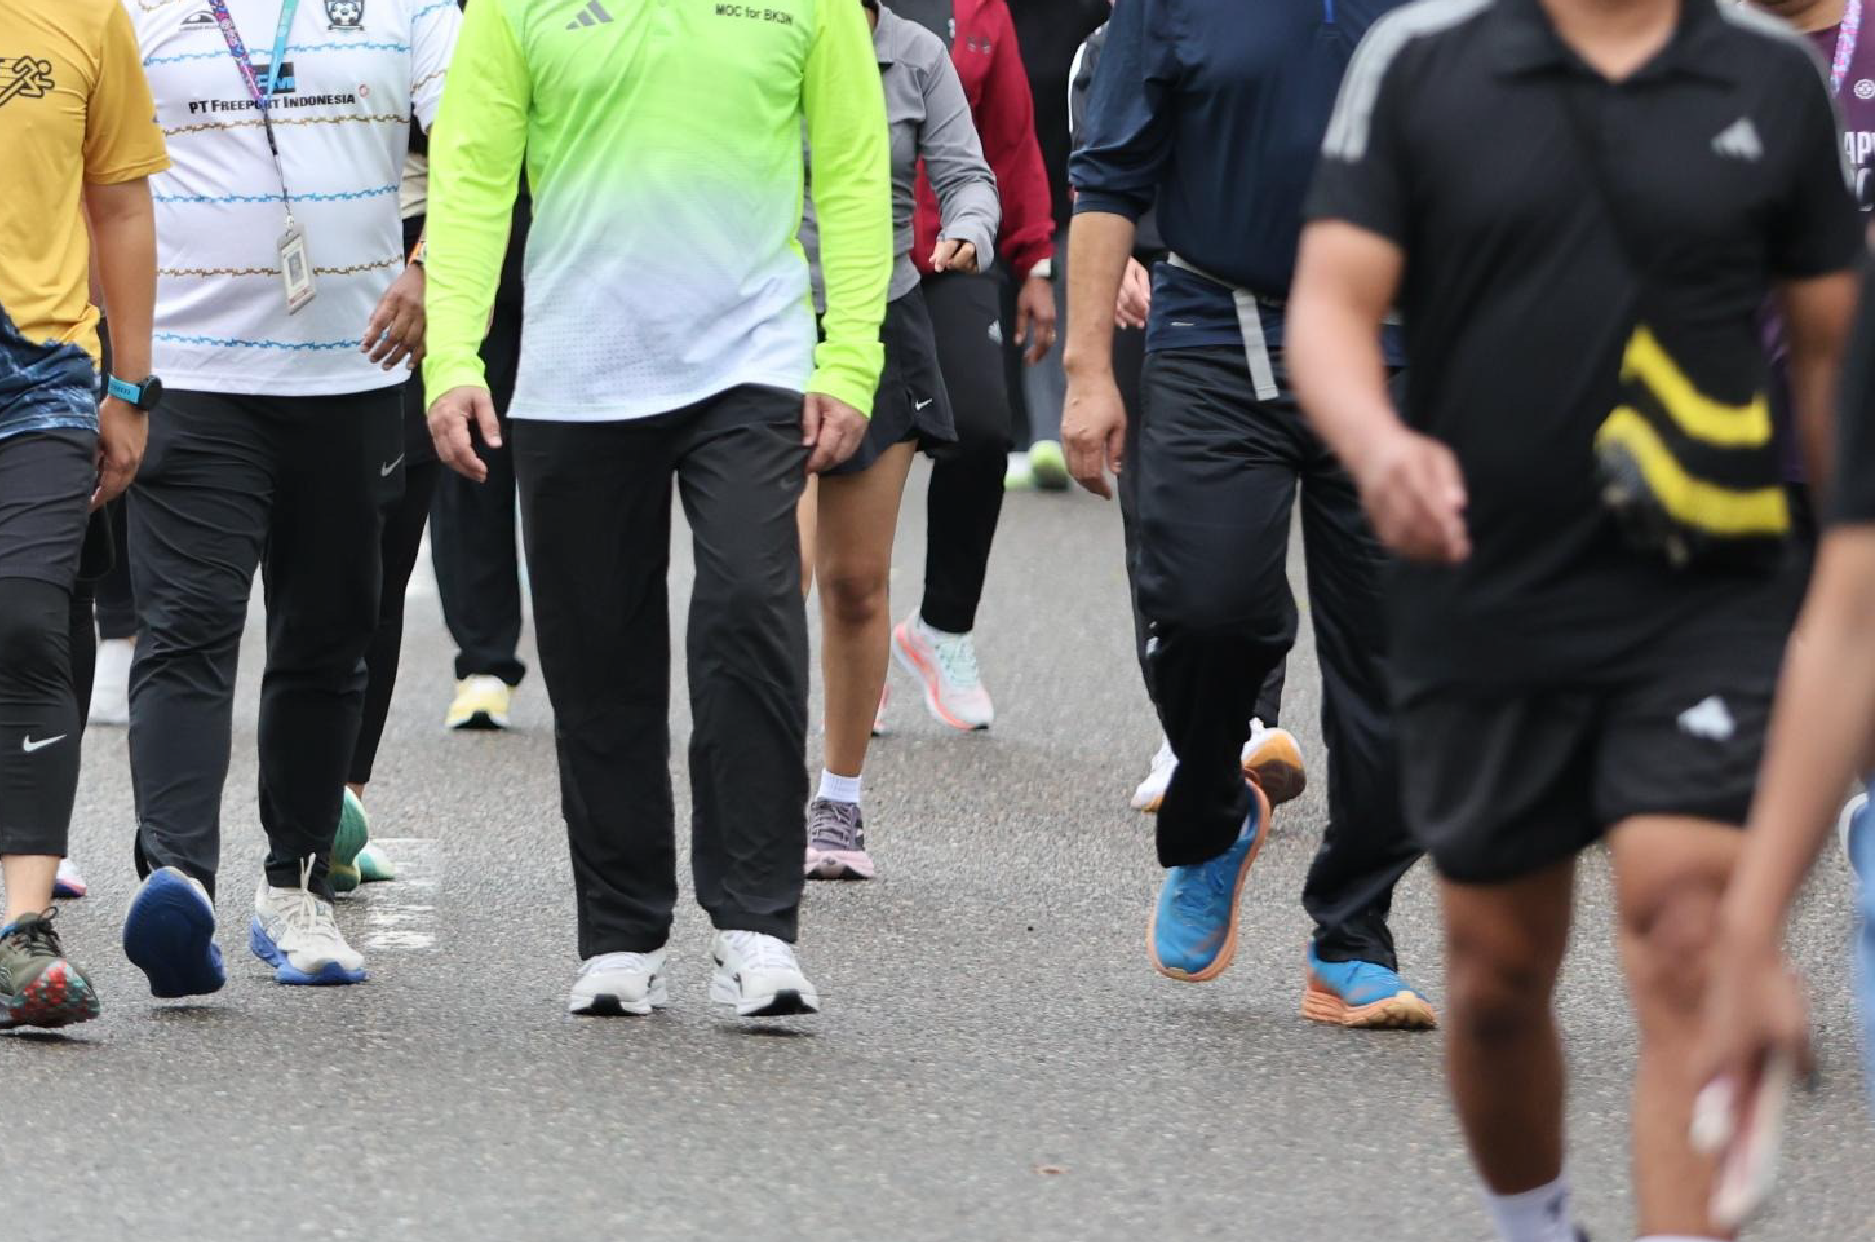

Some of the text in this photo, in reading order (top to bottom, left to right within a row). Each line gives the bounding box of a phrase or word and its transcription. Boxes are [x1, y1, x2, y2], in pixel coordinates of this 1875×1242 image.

[715, 3, 742, 17] MOC
[745, 6, 762, 18] for
[188, 99, 209, 114] PT
[283, 94, 356, 109] INDONESIA
